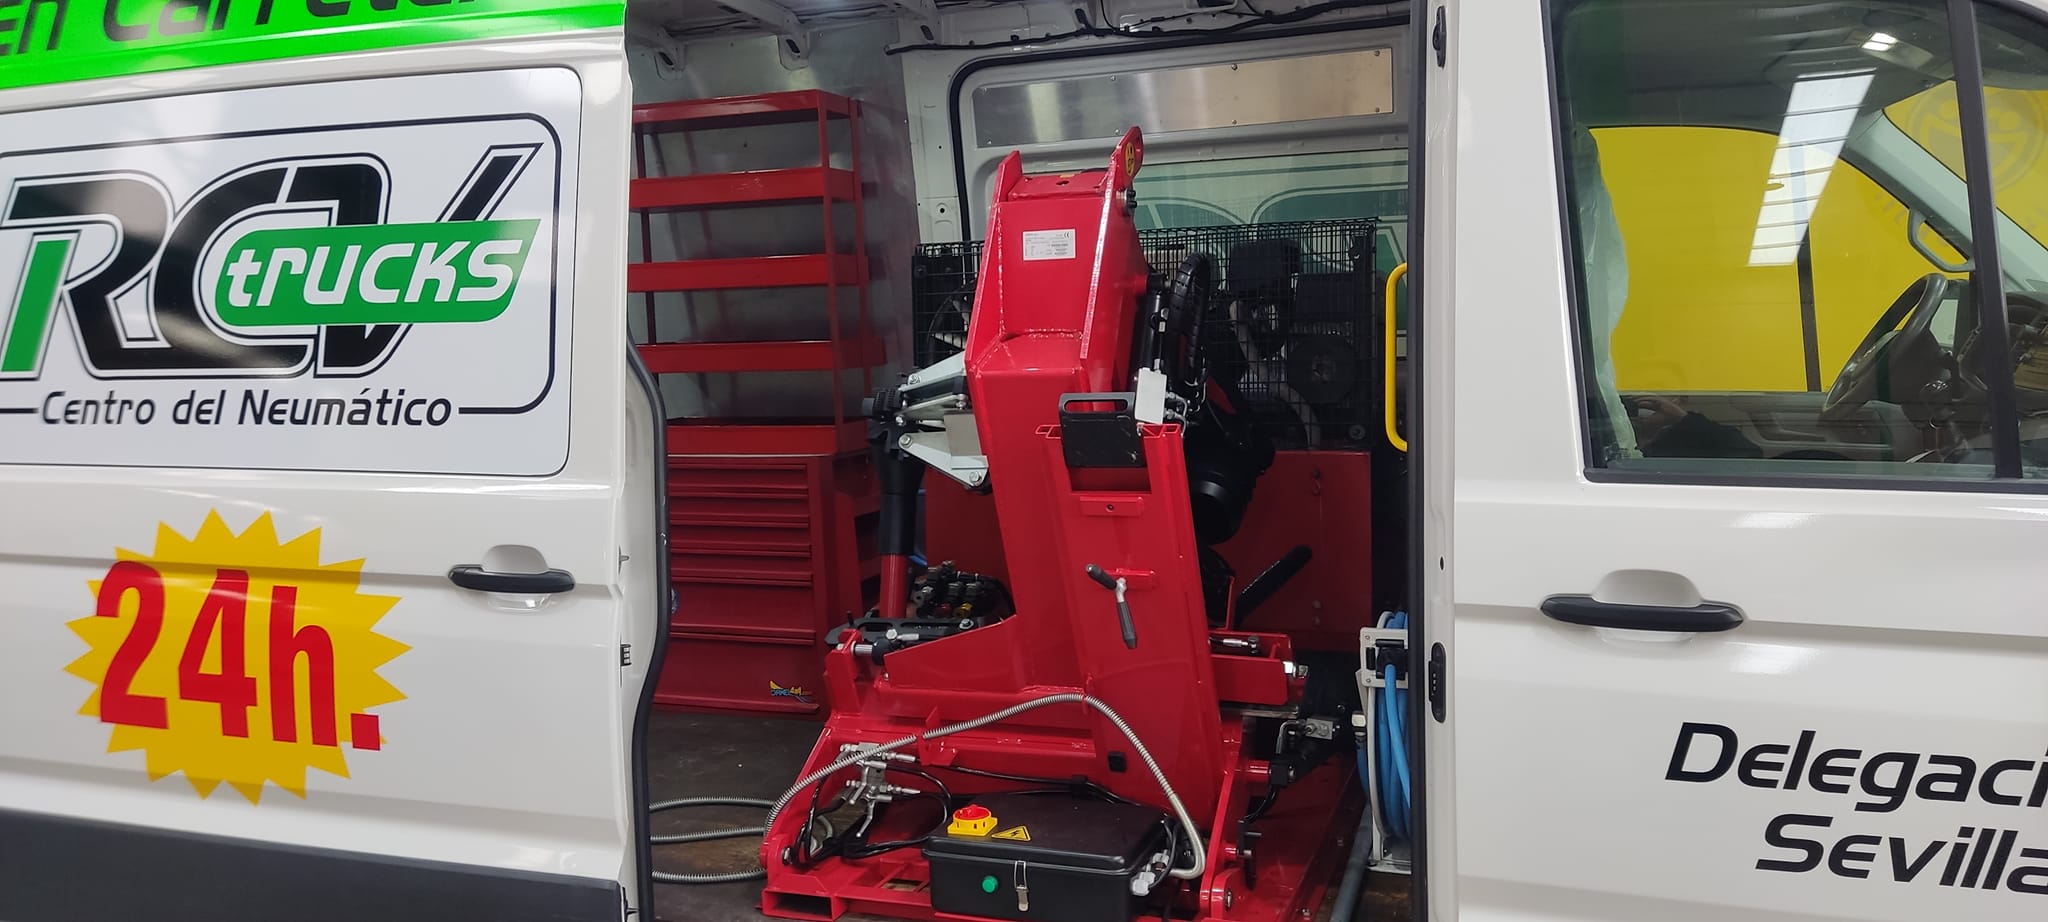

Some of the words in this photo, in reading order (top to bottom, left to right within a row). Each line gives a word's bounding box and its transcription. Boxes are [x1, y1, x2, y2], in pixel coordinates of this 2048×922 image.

[0, 143, 543, 381] RCV
[226, 239, 524, 307] trucks
[41, 390, 155, 426] Centro
[172, 390, 225, 426] del
[238, 388, 452, 427] Neumático
[96, 560, 381, 751] 24h.
[1755, 814, 2048, 895] Sevilla
